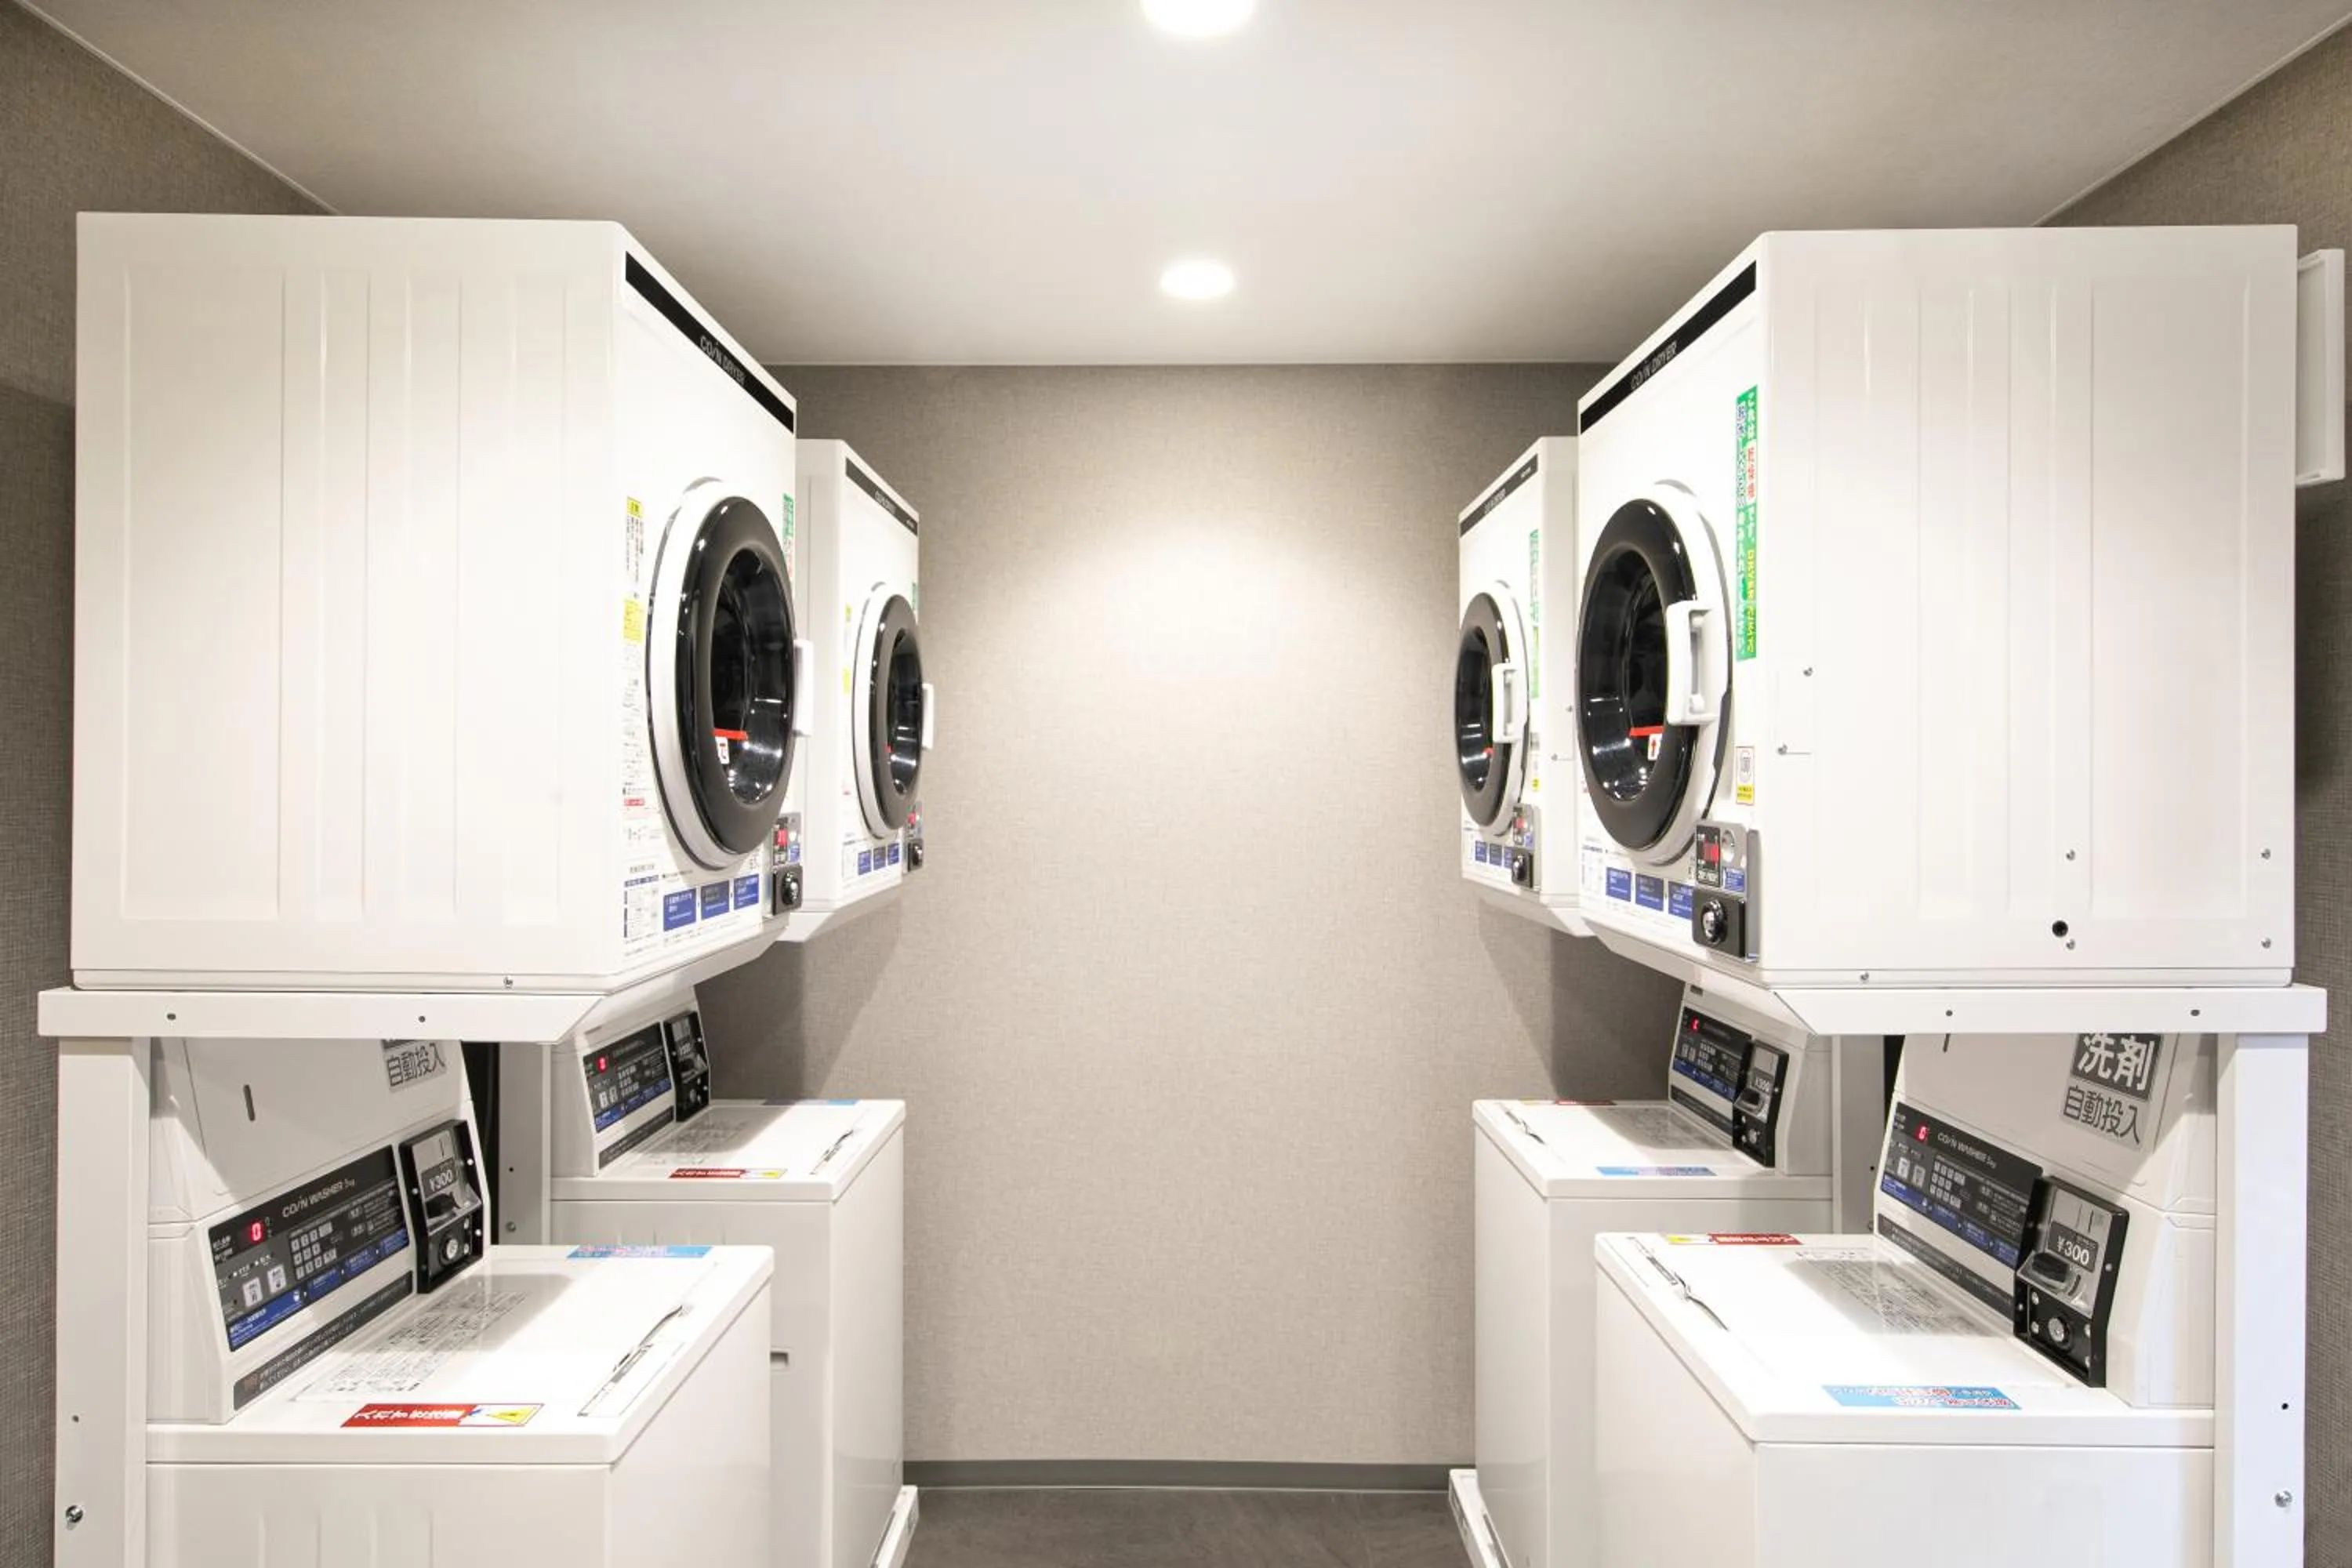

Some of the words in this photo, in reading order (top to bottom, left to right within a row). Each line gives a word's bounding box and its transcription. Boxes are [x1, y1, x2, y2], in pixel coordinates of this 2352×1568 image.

[387, 1042, 446, 1087] 自動投入
[2078, 1033, 2154, 1091] 洗剤
[2063, 1085, 2140, 1145] 自動投入
[252, 1221, 263, 1241] 0
[2056, 1236, 2090, 1265] ¥300
